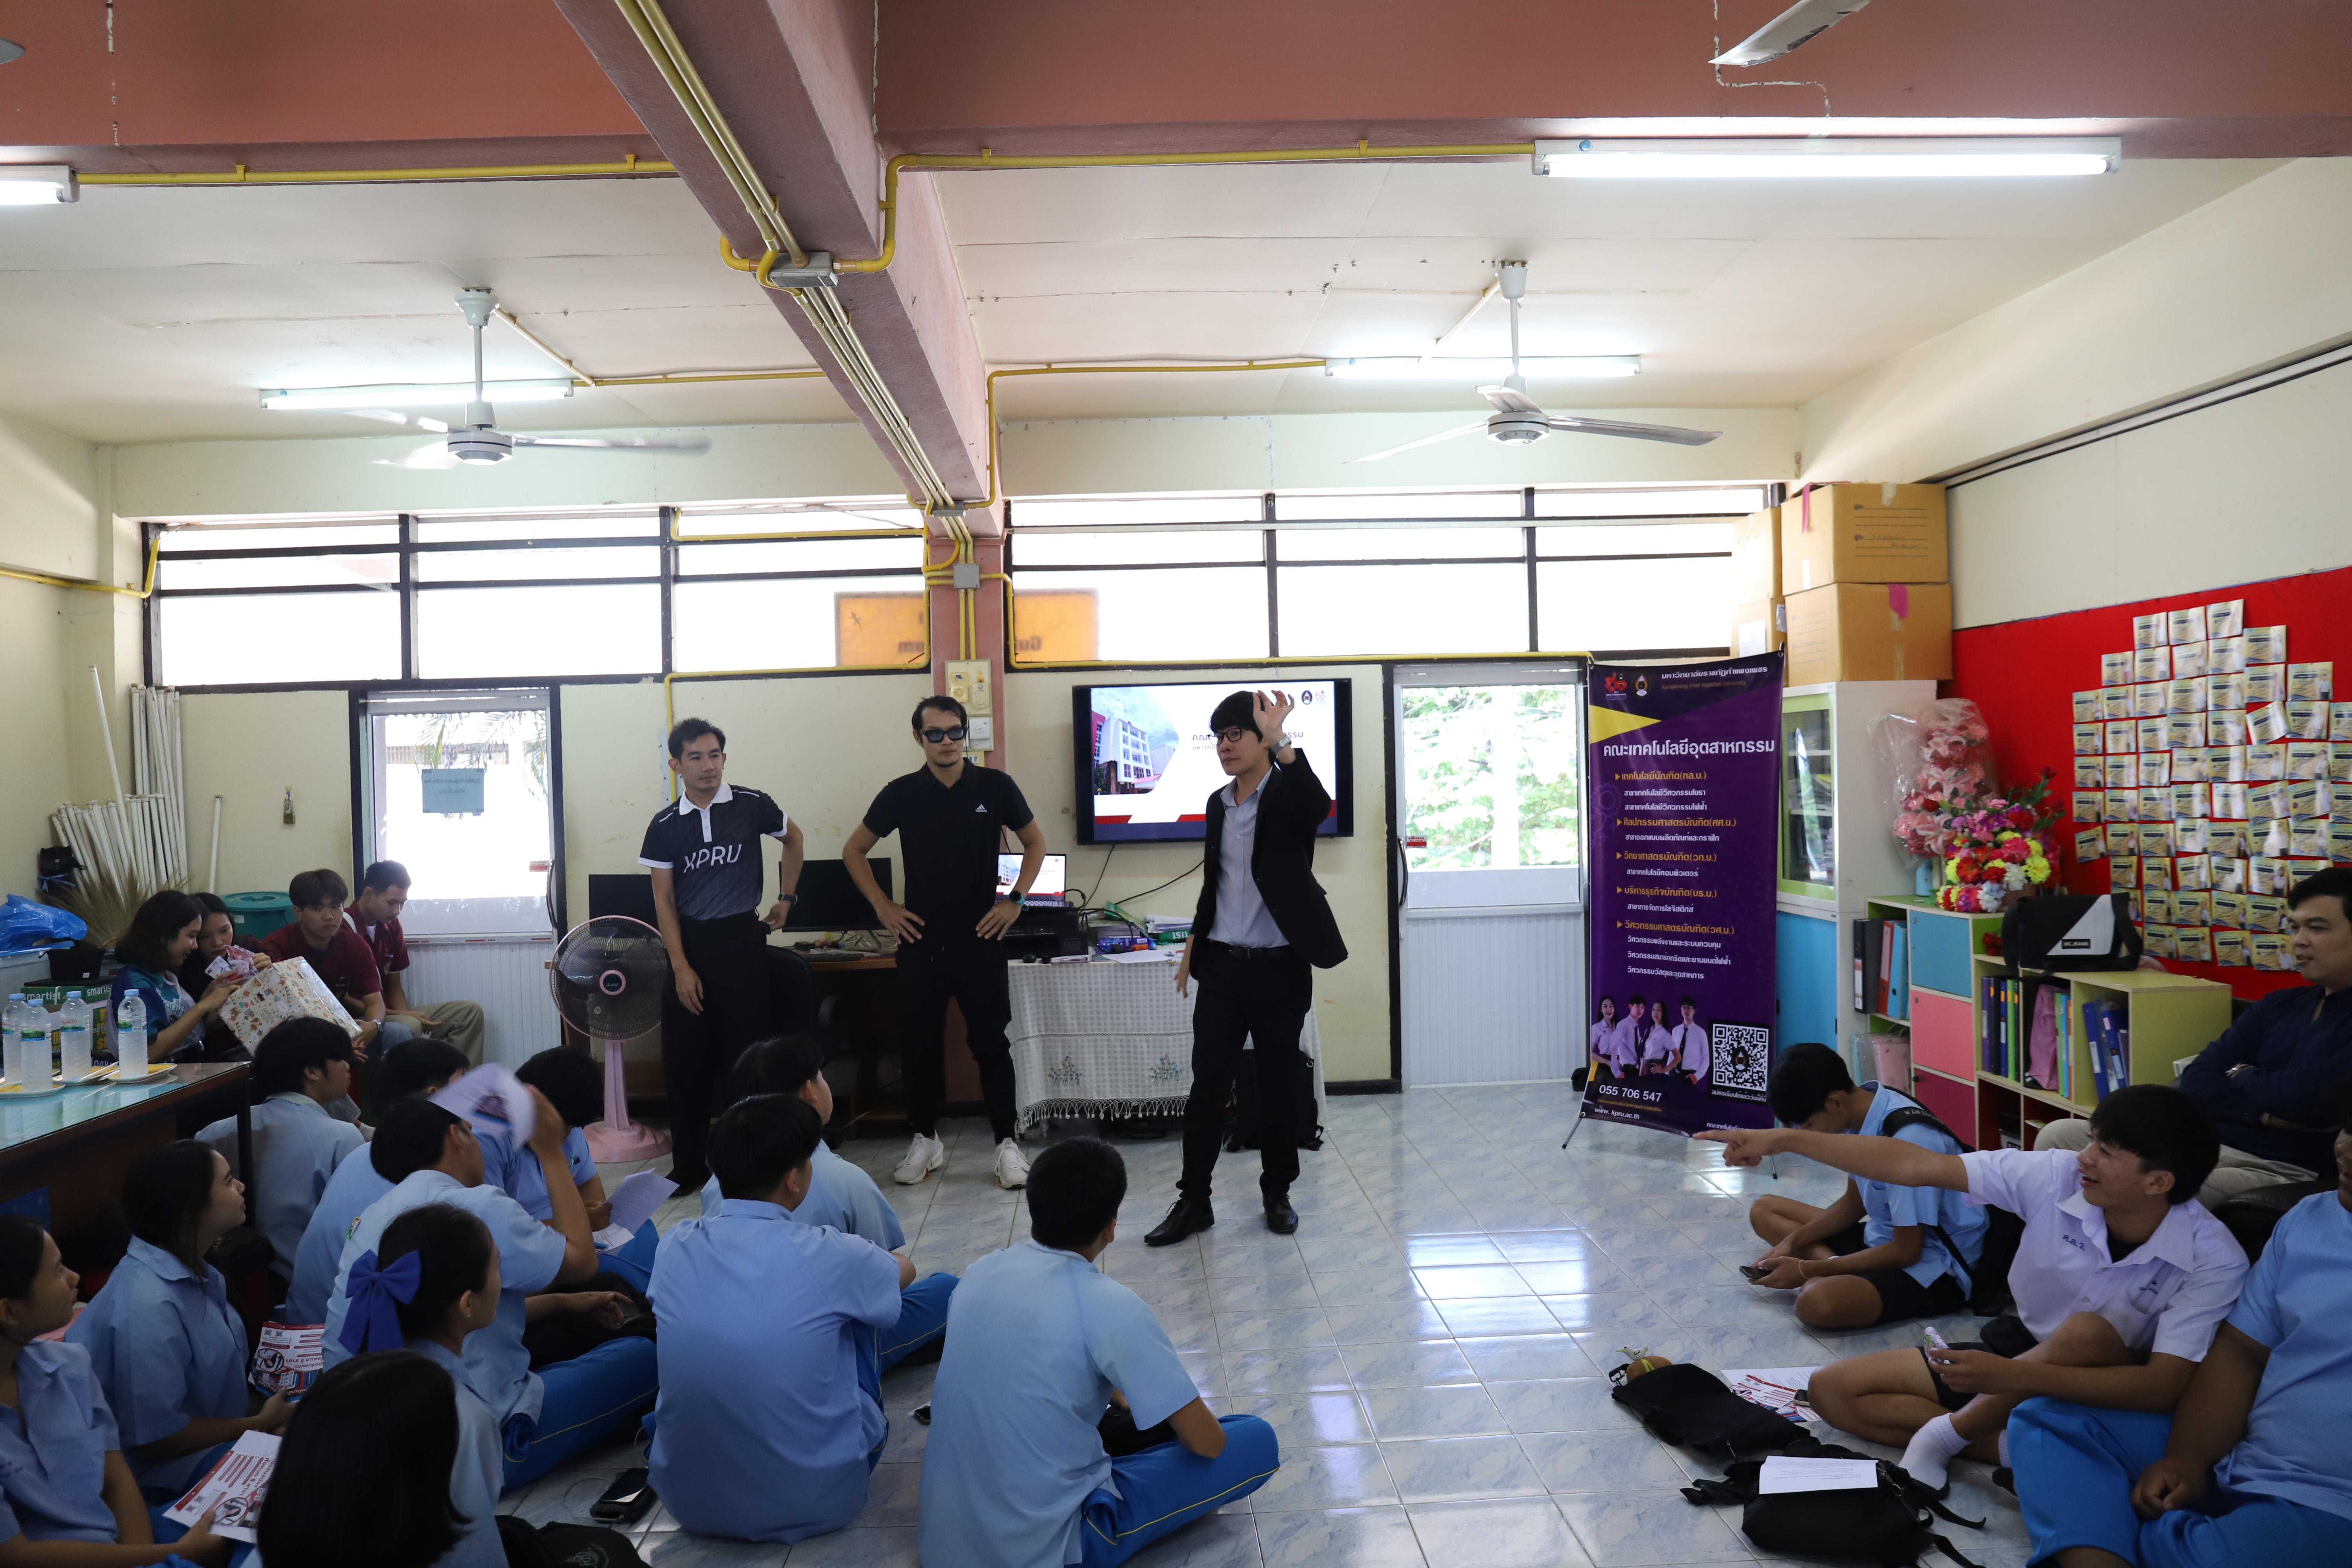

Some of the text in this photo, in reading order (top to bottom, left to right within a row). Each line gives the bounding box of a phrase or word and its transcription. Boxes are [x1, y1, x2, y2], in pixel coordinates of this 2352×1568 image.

[1661, 666, 1767, 679] มหาวิทยาลัยราชภัฏกำแพงเพชร
[1603, 738, 1775, 759] คณะเทคโนโลยีอุตสาหกรรม
[1622, 770, 1706, 780] เทคโนโลยีบัณฑิต(ทล.บ.)
[1625, 800, 1707, 810] สาขาเทคโนโลยีวิศวกรรมไฟฟ้า
[1624, 818, 1736, 827] ศิลปกรรมศาสตรบัณฑิต(ศศ.บ.)
[1624, 851, 1717, 862] วิทยาศาสตรบัณฑิต(วท.บ.)
[1626, 868, 1699, 877] สาขาเทคโนโลยีคอมพิวเตอร์
[1627, 903, 1694, 913] สาขาการจัดการโลจิสติกส์
[1625, 920, 1734, 935] วิศวกรรมศาสตรบัณฑิต(วศ.บ.)
[1627, 936, 1721, 949] วิศวกรรมพลังงานและระบบควบคุม
[87, 985, 113, 997] smartis
[1599, 1085, 1661, 1102] 055 706 547
[1611, 1110, 1640, 1119] kpru.ac.th
